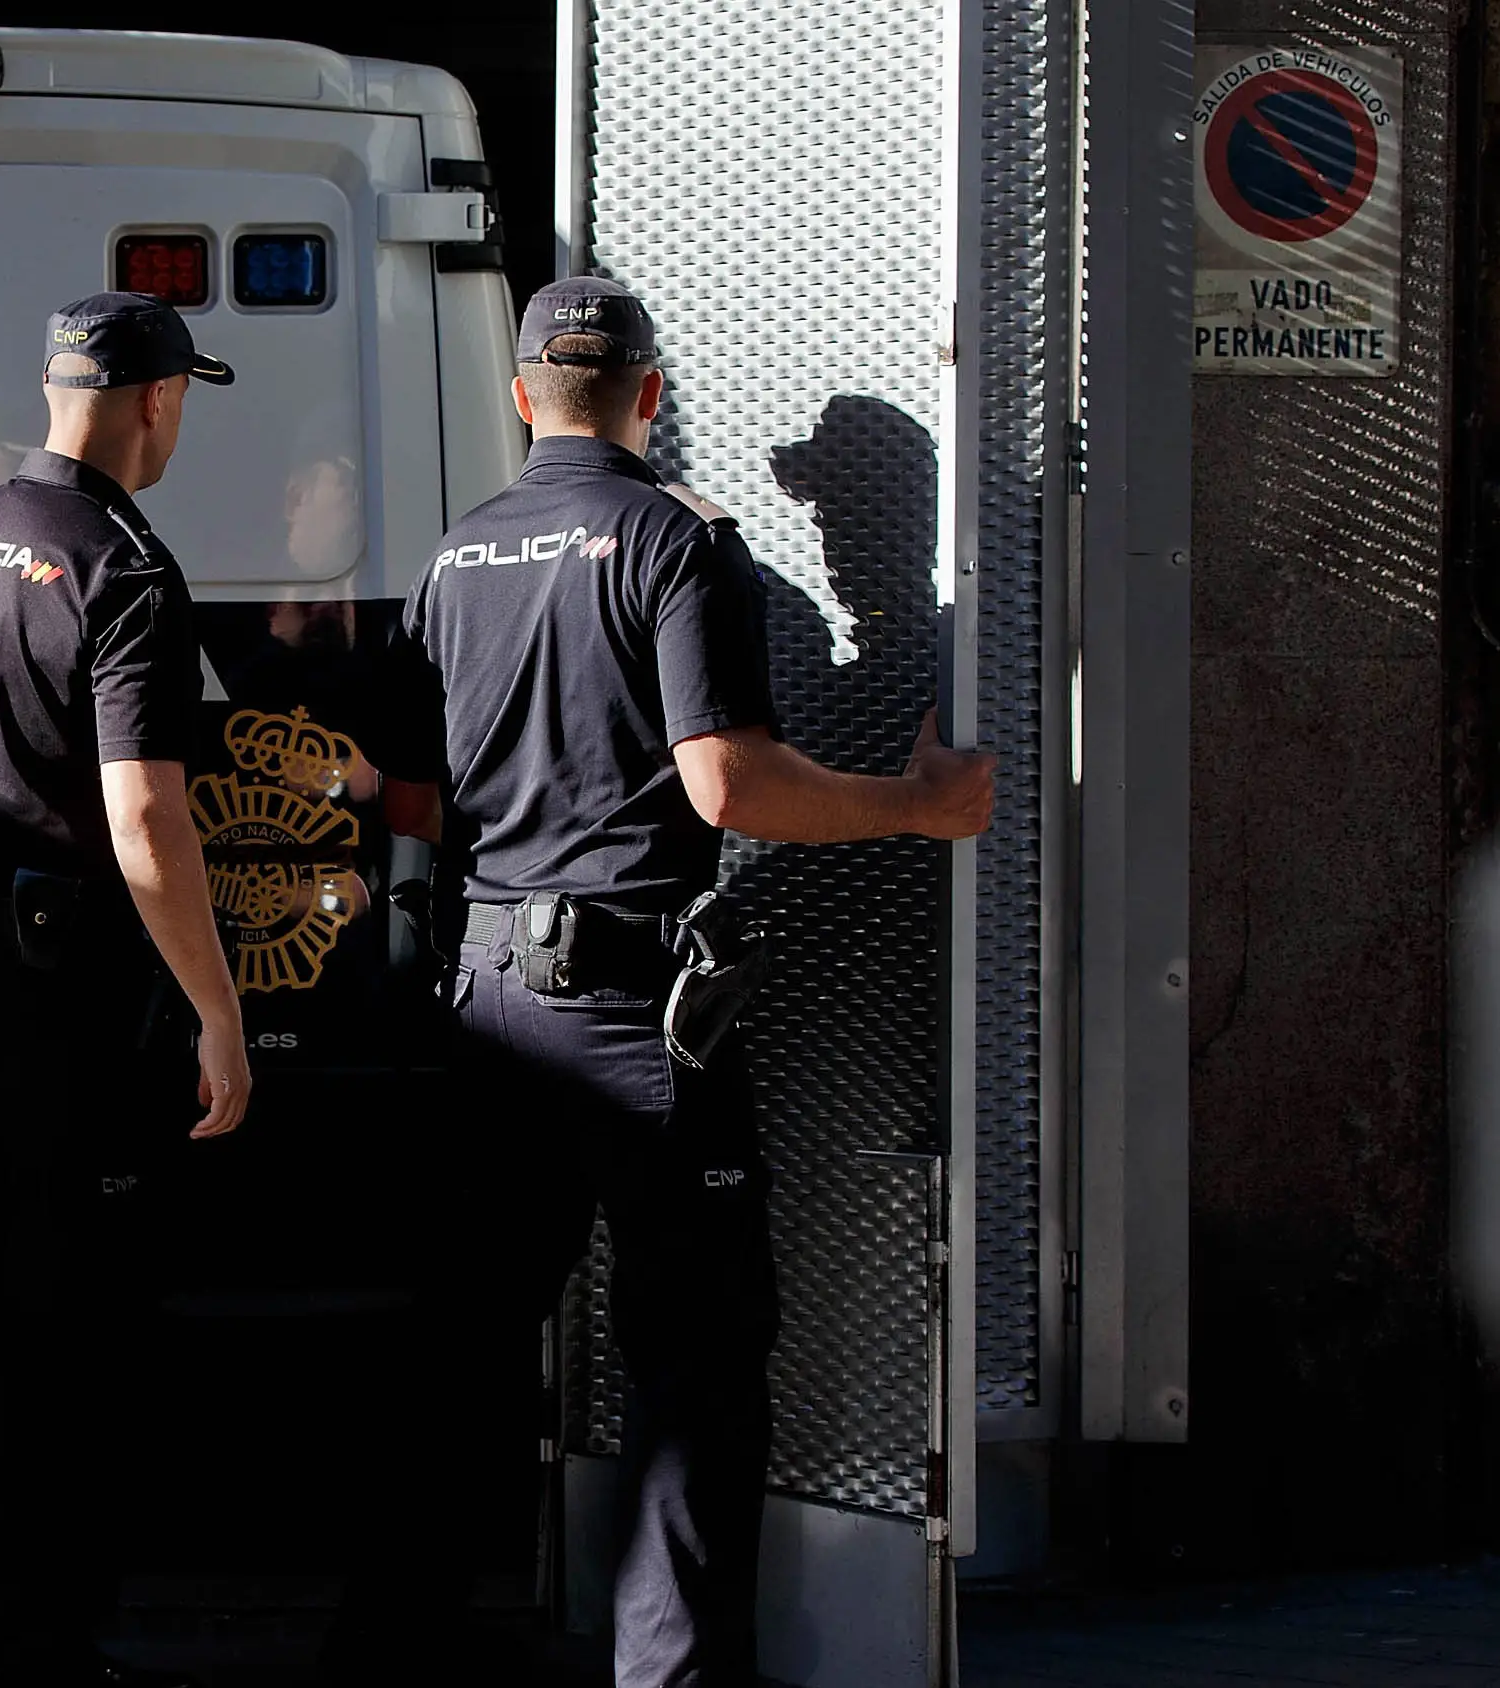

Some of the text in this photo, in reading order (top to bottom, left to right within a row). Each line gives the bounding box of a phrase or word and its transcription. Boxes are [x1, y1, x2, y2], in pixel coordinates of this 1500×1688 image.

[1193, 51, 1391, 126] SALIDA DE VEHICULOS
[1250, 279, 1332, 311] VADO
[554, 307, 598, 321] CNP
[53, 329, 89, 345] CNP
[1195, 326, 1385, 359] PERMANENTE
[433, 526, 587, 581] POLICIA
[101, 1174, 138, 1194] CNP
[704, 1169, 745, 1187] CNP
